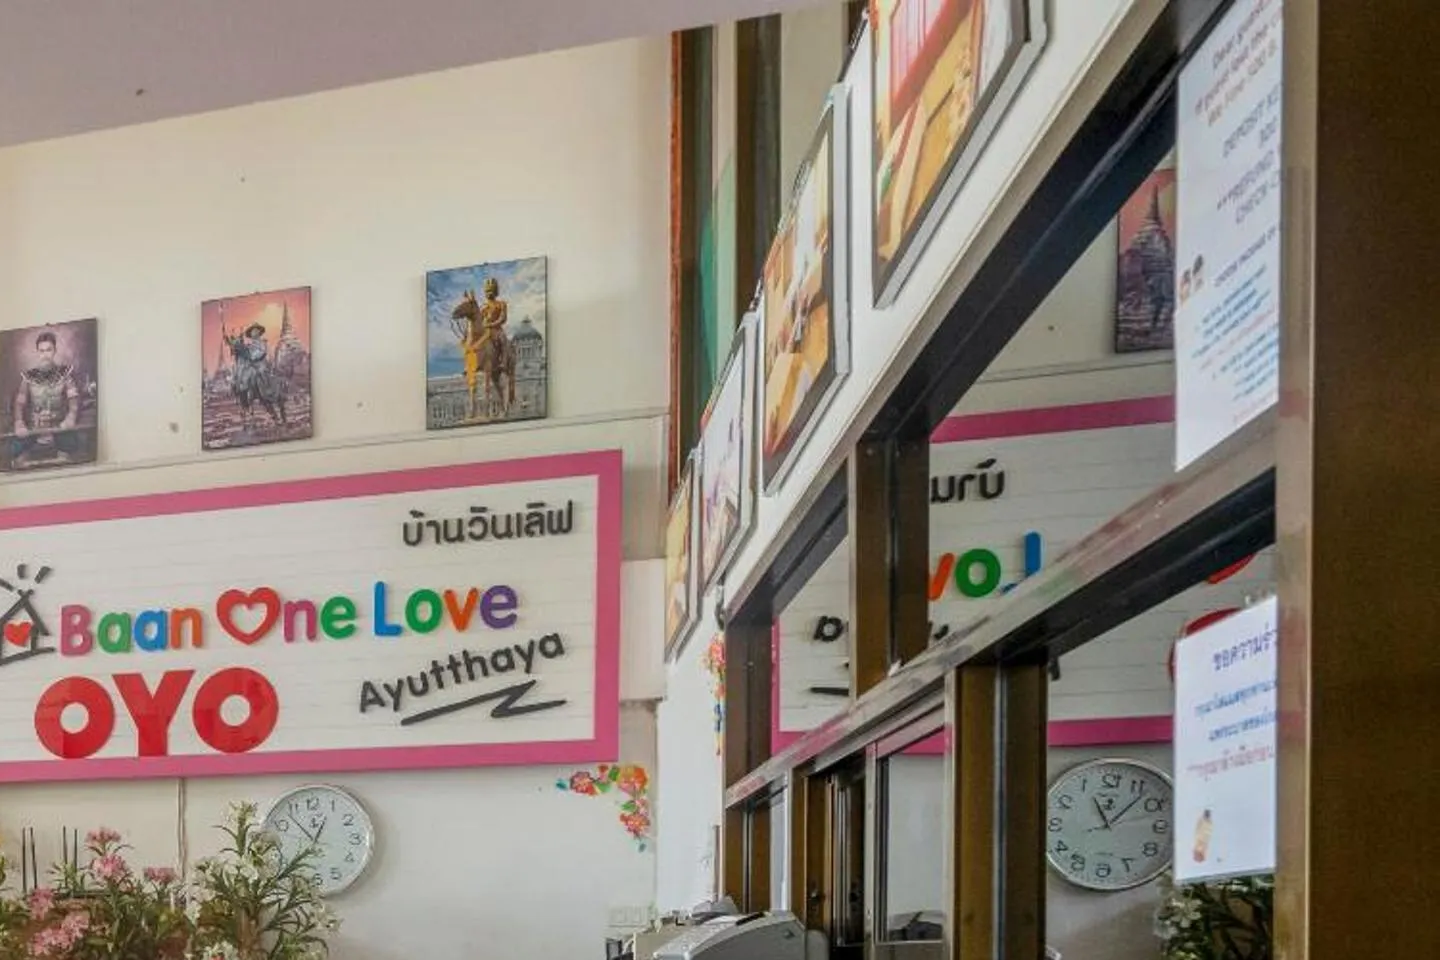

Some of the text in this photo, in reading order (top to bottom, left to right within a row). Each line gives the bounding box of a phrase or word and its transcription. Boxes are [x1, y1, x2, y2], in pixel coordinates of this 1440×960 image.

[402, 499, 574, 549] บ้านวินเลิฟ
[60, 603, 203, 658] Baan
[374, 581, 519, 637] Love
[358, 630, 567, 713] Ayutthaya
[34, 667, 280, 759] OYO
